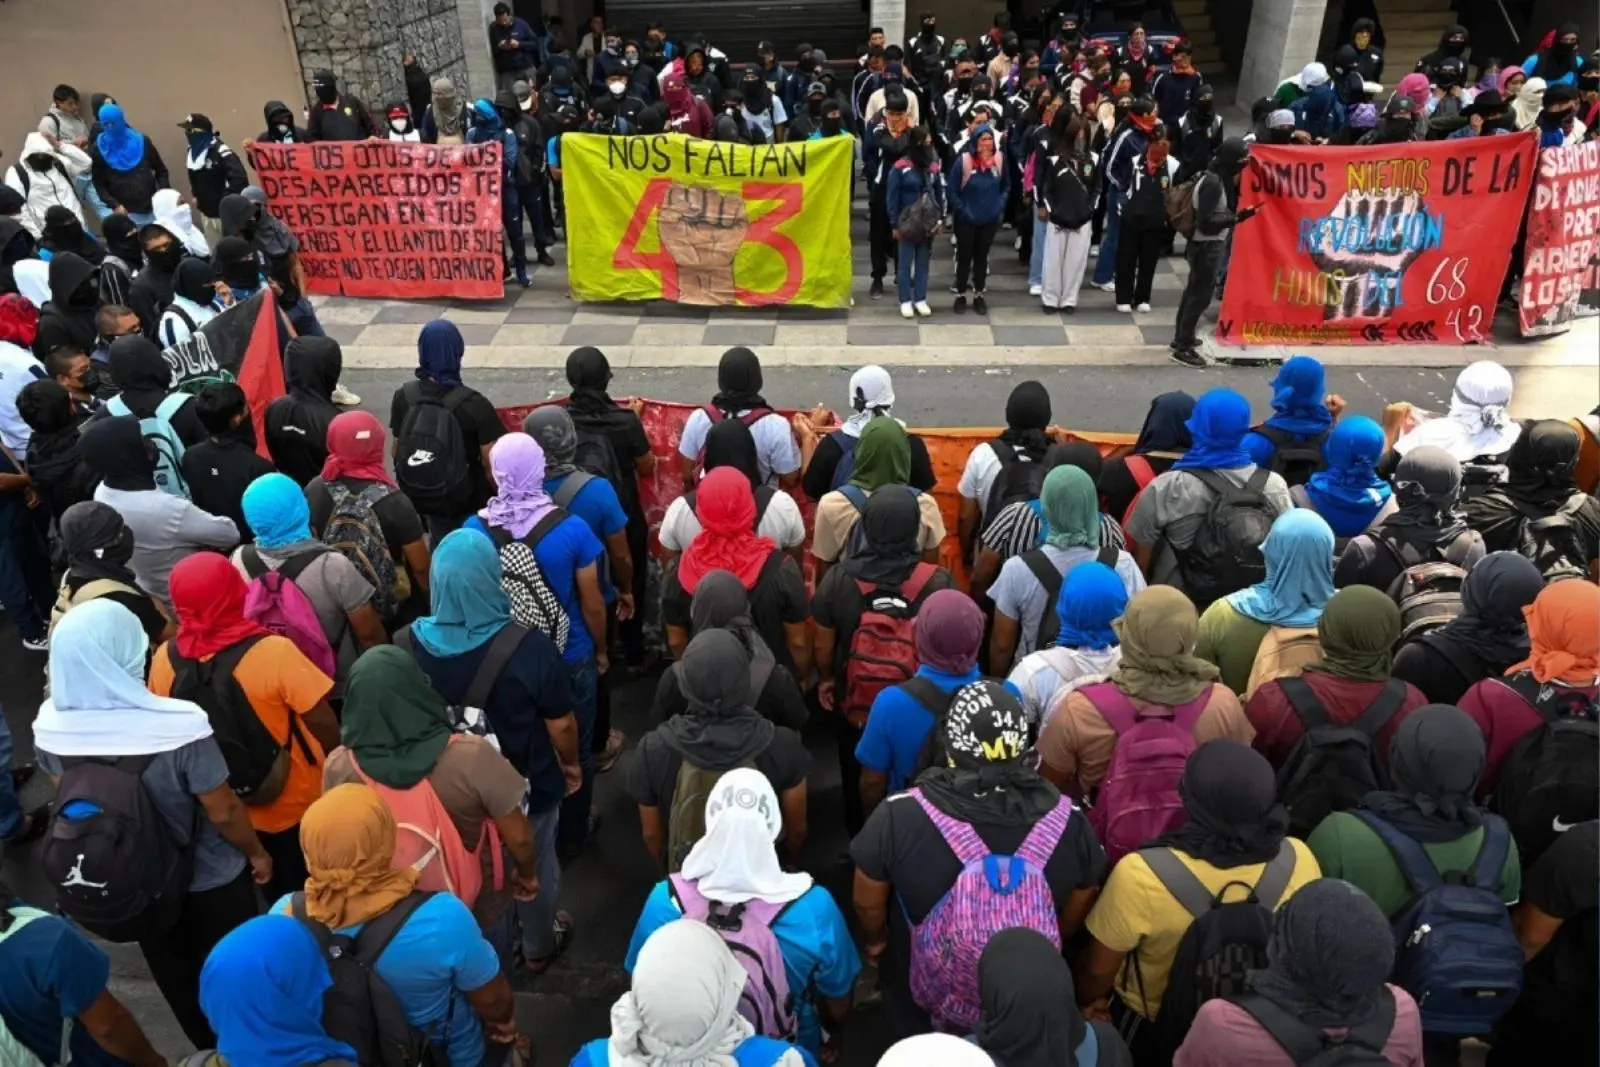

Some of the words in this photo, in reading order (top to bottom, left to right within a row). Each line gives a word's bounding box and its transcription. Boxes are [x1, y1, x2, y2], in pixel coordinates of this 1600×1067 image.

[255, 148, 299, 171] QUE
[425, 147, 451, 168] DE
[608, 135, 671, 172] NOS
[684, 140, 806, 176] FALTAN
[261, 172, 462, 199] DESAPARECIDOS
[473, 170, 498, 196] TE
[1250, 155, 1327, 199] SOMOS
[1347, 158, 1431, 197] NIETOS
[1443, 156, 1477, 196] DE
[1488, 151, 1521, 193] LA
[1534, 180, 1560, 211] DE
[271, 202, 389, 227] PERSIGAN
[398, 201, 425, 225] EN
[436, 201, 477, 225] TUS
[344, 230, 356, 252] Y
[363, 231, 382, 252] EL
[384, 230, 447, 252] LLANTO
[451, 230, 470, 253] DE
[612, 177, 804, 307] 43
[341, 257, 363, 280] NO
[363, 257, 384, 278] TE
[384, 257, 425, 281] DEJEN
[428, 257, 496, 281] DORMIR
[1272, 266, 1347, 306] HIJOS
[1363, 268, 1404, 307] DEL
[1426, 256, 1469, 304] 68
